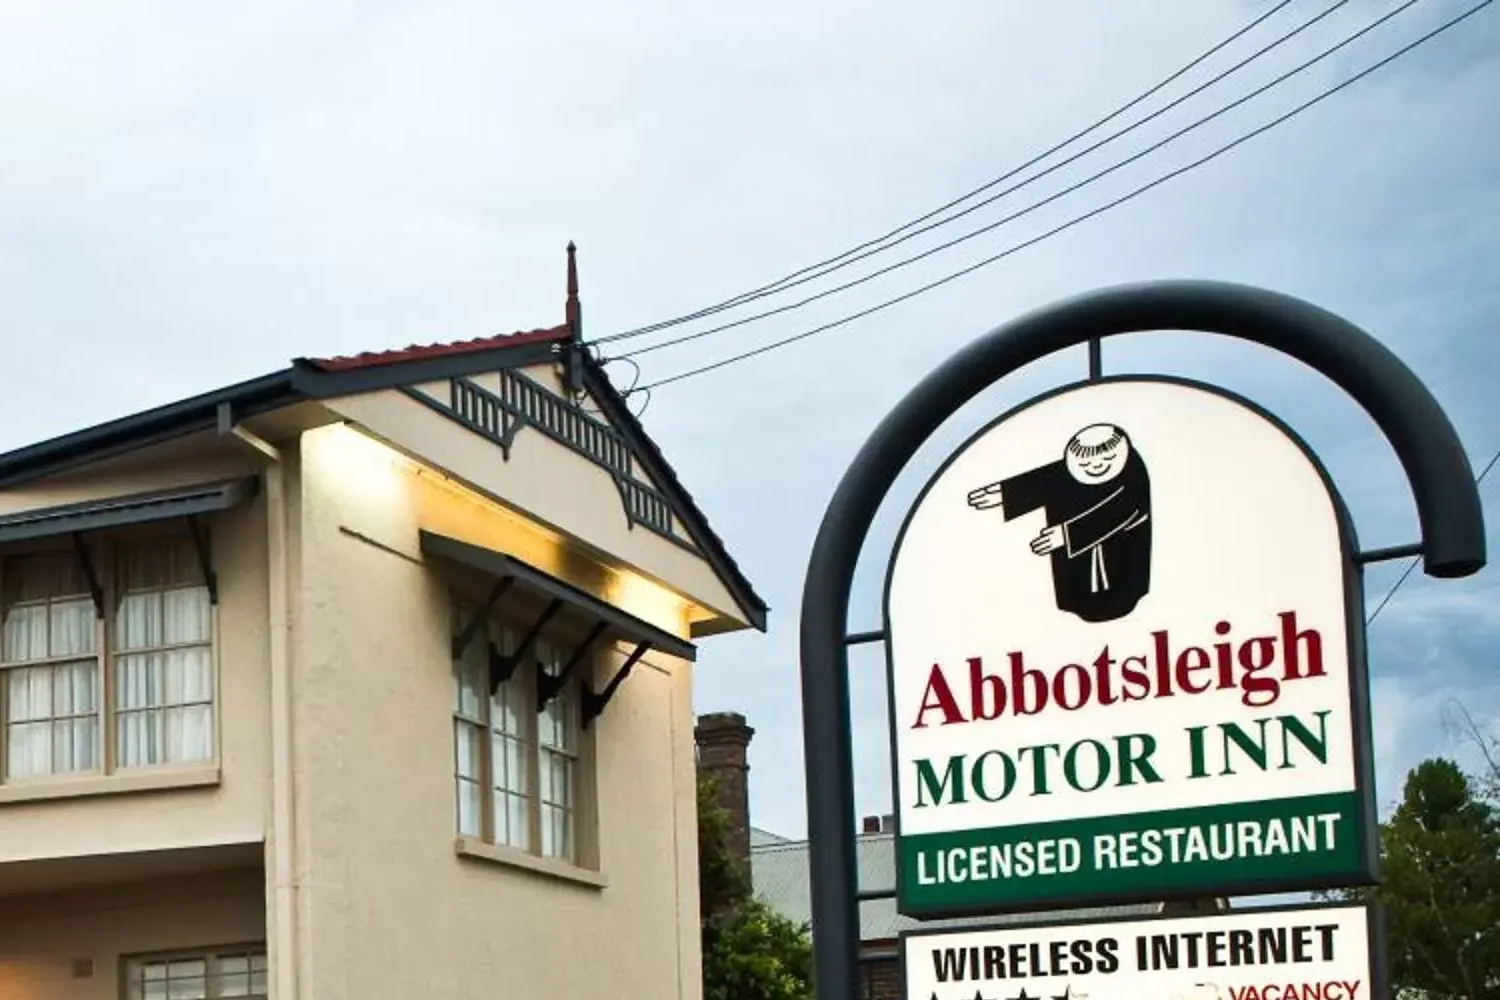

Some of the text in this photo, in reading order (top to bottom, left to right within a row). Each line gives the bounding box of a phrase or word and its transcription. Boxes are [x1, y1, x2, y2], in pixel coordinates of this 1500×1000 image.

[911, 611, 1328, 729] Abbotsleigh
[911, 710, 1333, 808] MOTOR INN
[917, 813, 1341, 886] LICENSED RESTAURANT
[932, 924, 1340, 983] WIRELESS INTERNET
